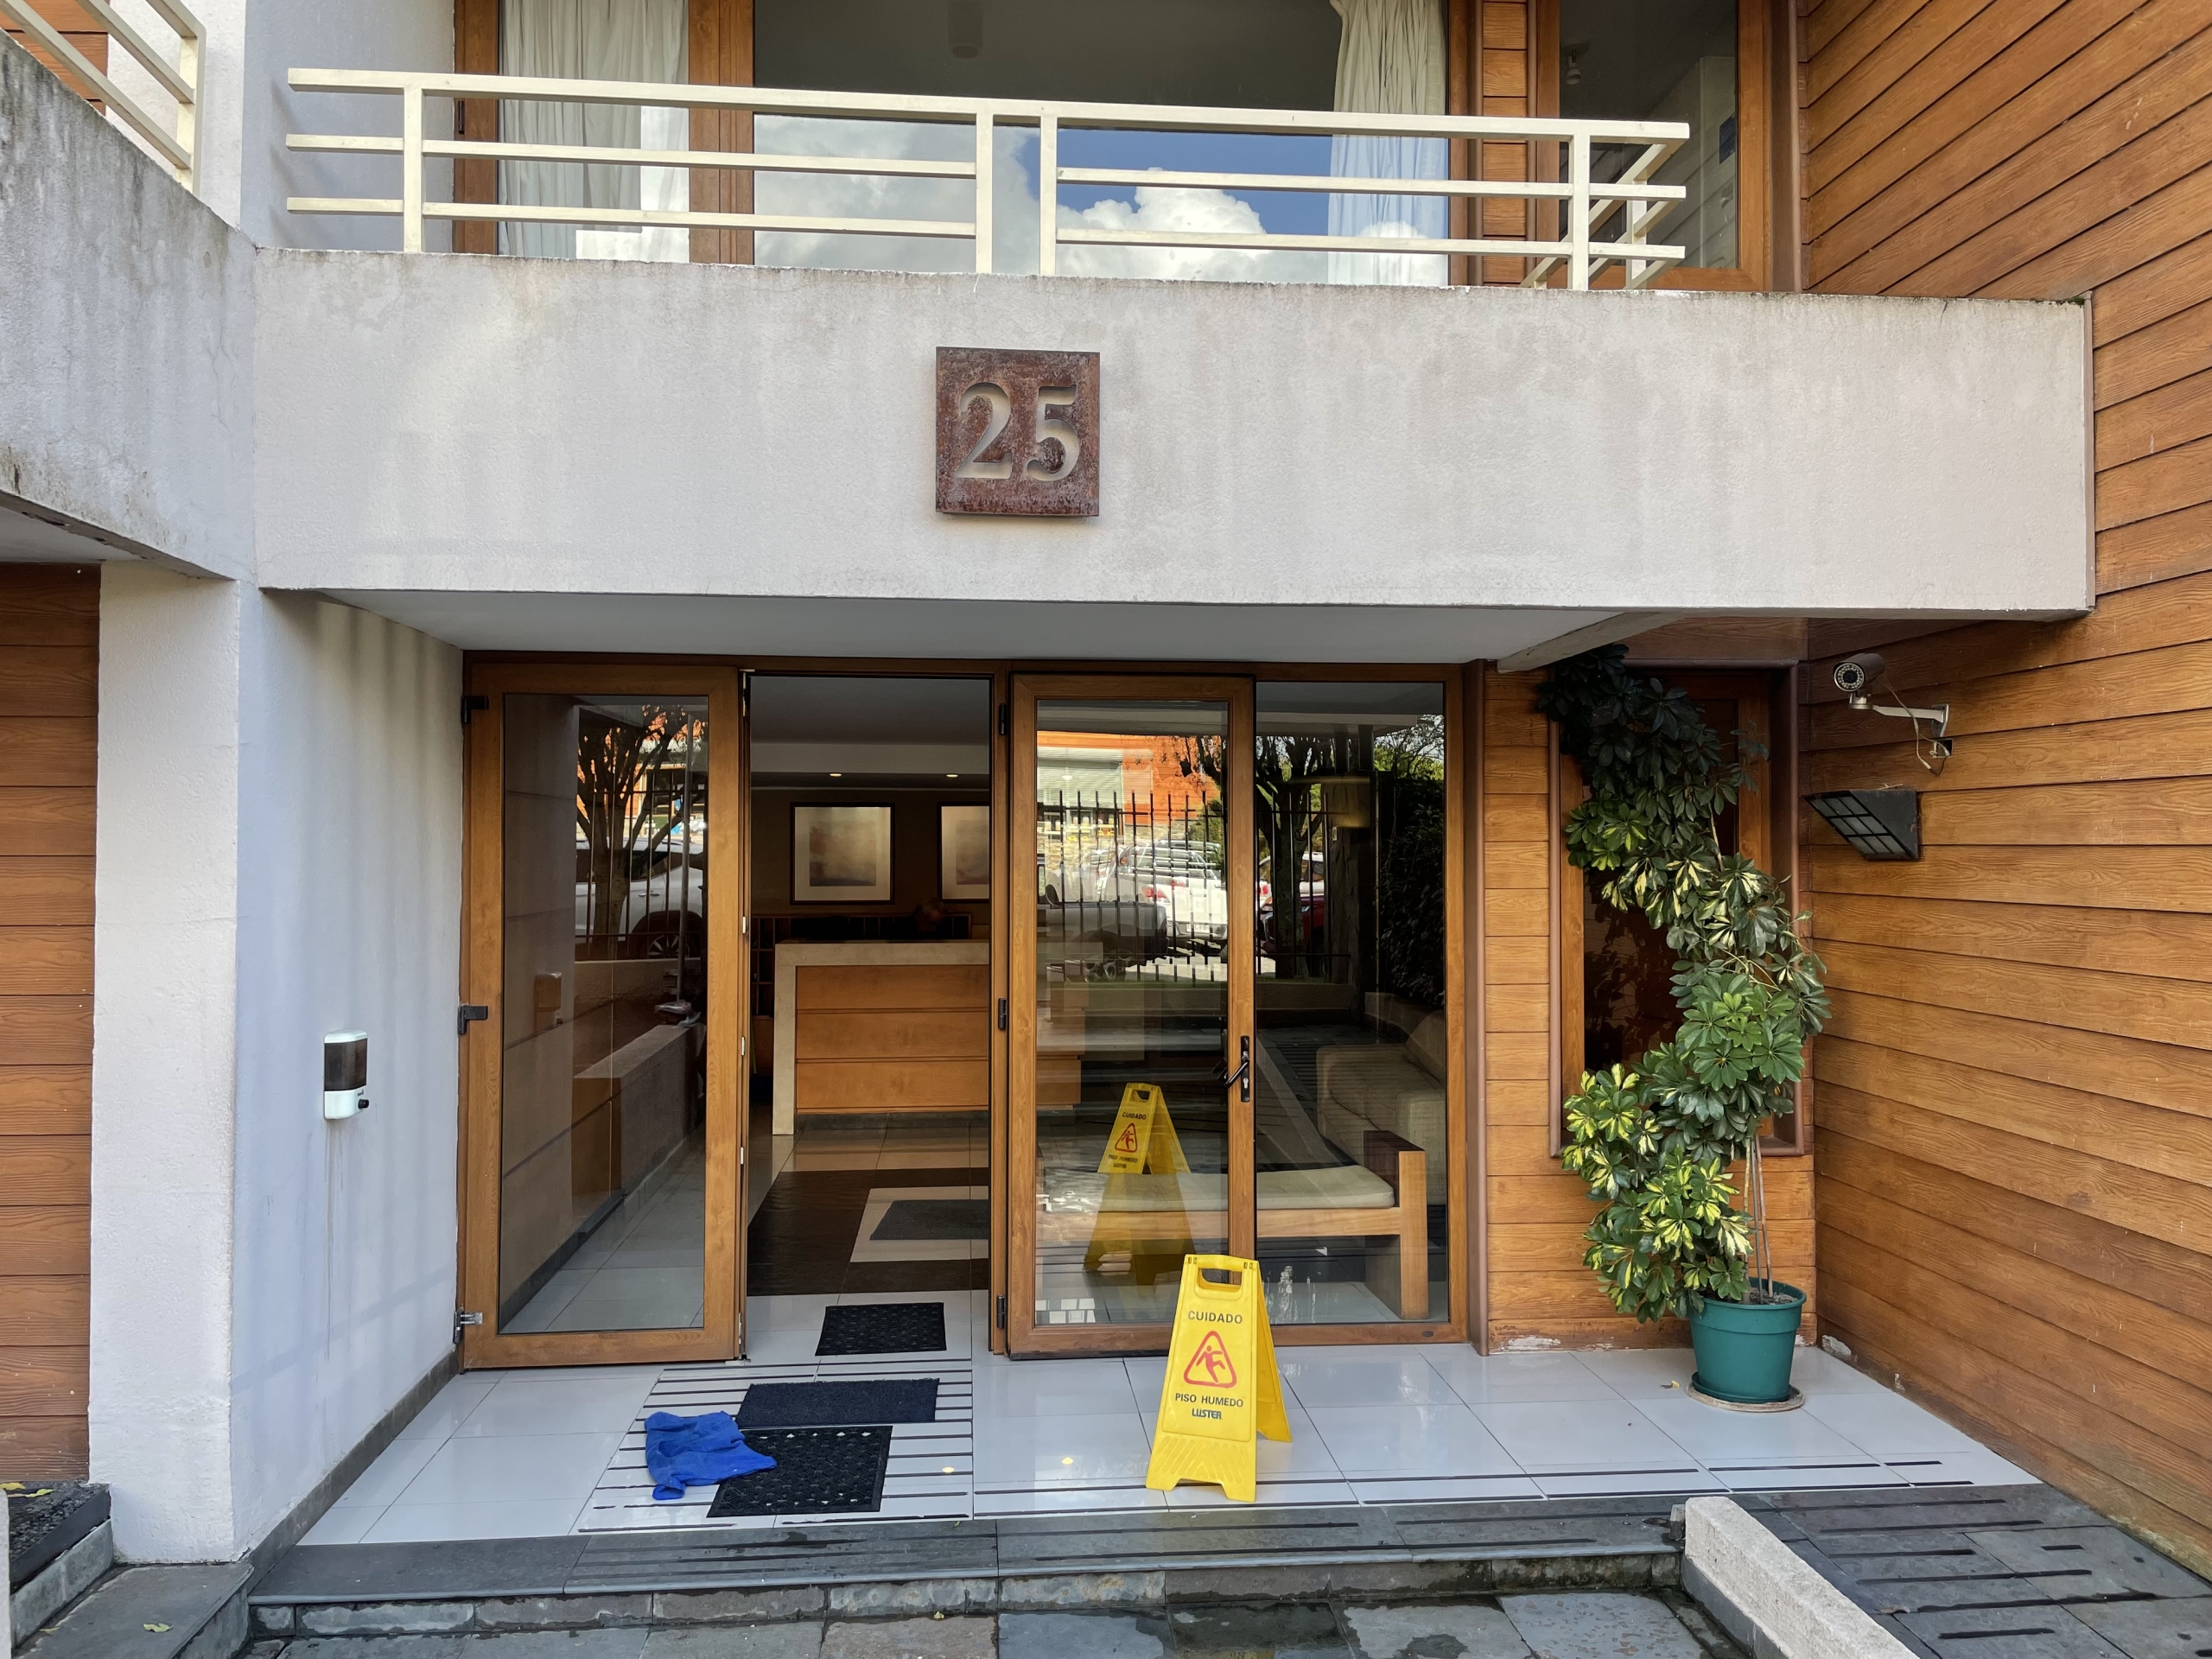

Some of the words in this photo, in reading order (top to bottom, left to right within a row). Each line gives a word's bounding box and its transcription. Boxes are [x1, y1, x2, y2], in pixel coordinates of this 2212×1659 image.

[956, 382, 1080, 481] 25
[1122, 1111, 1147, 1120] CUIDADO
[1187, 1310, 1243, 1325] CUIDADO
[1174, 1392, 1197, 1403] PISO
[1201, 1395, 1244, 1408] HUMEDO
[1192, 1408, 1222, 1420] LUSTER
